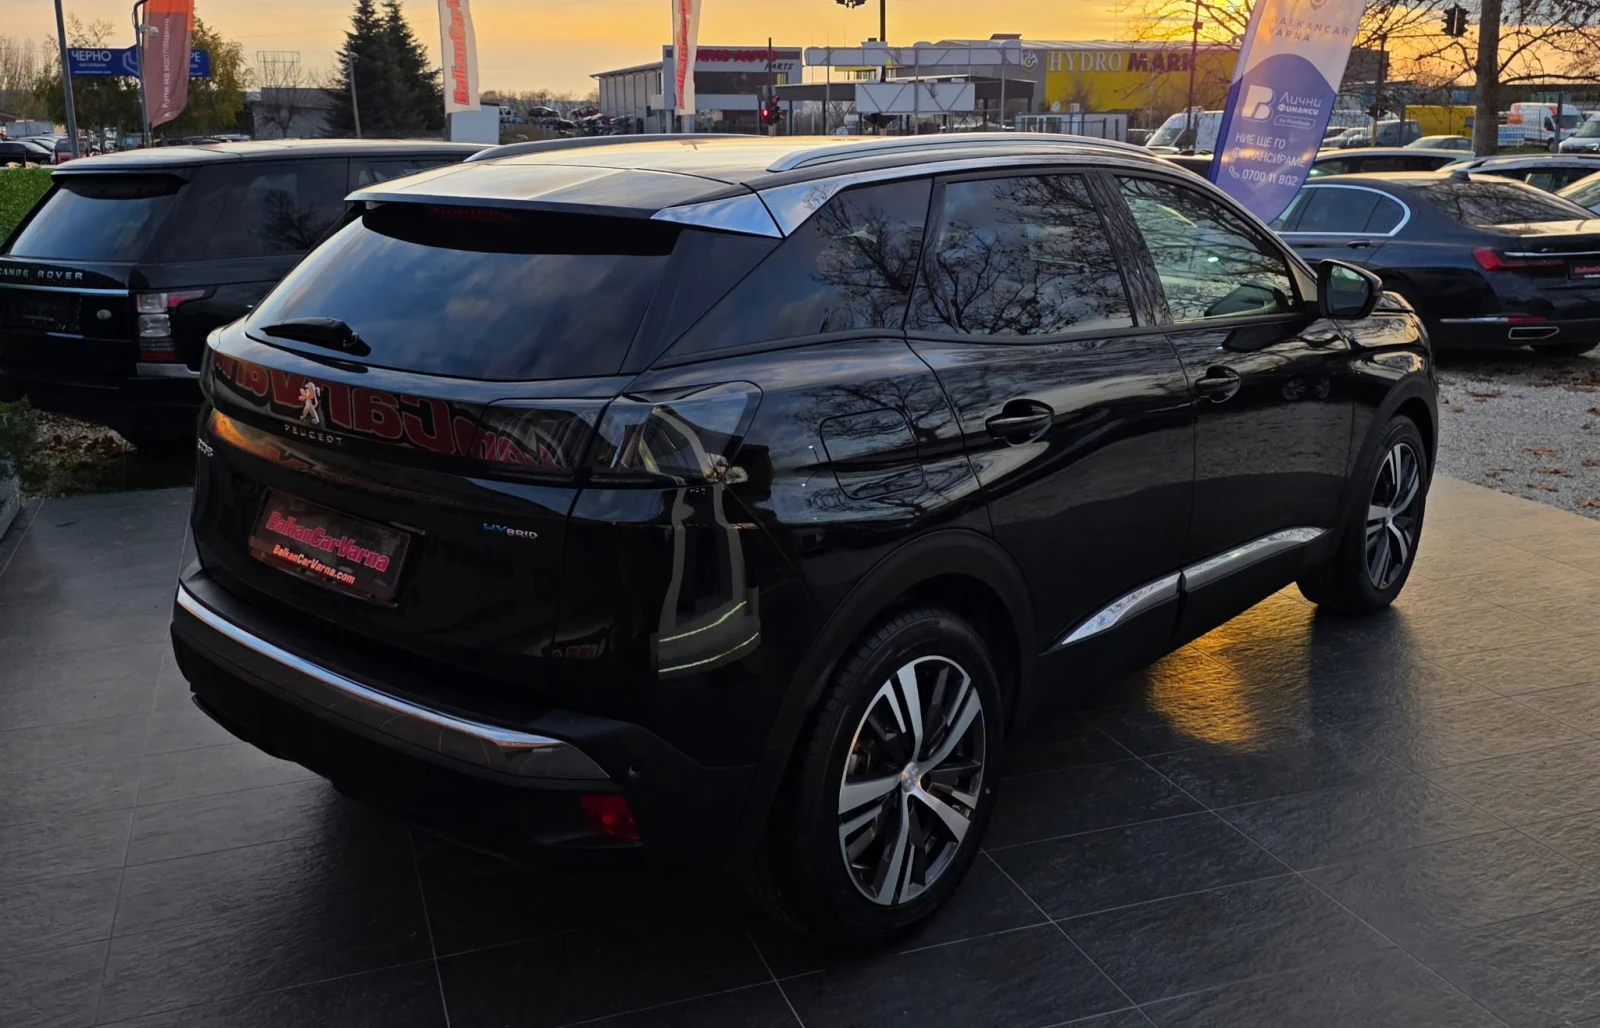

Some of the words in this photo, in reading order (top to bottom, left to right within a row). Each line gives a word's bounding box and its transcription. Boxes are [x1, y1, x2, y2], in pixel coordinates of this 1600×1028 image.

[1268, 26, 1311, 42] VARNA
[1271, 17, 1349, 36] BALKANCAR
[71, 50, 112, 61] ЧЕРНО
[1050, 52, 1122, 72] HYDRO
[1127, 52, 1195, 72] MARK
[1235, 132, 1255, 145] НИЕ
[1256, 136, 1272, 148] ЩЕ
[1273, 139, 1286, 149] ГО
[1242, 168, 1266, 181] 0700
[1268, 173, 1277, 183] 11
[37, 270, 83, 280] ROVER
[284, 423, 343, 445] PEUGEOT
[265, 511, 390, 573] BalkanCarVarna
[272, 544, 356, 585] BalkanCarVarna.com
